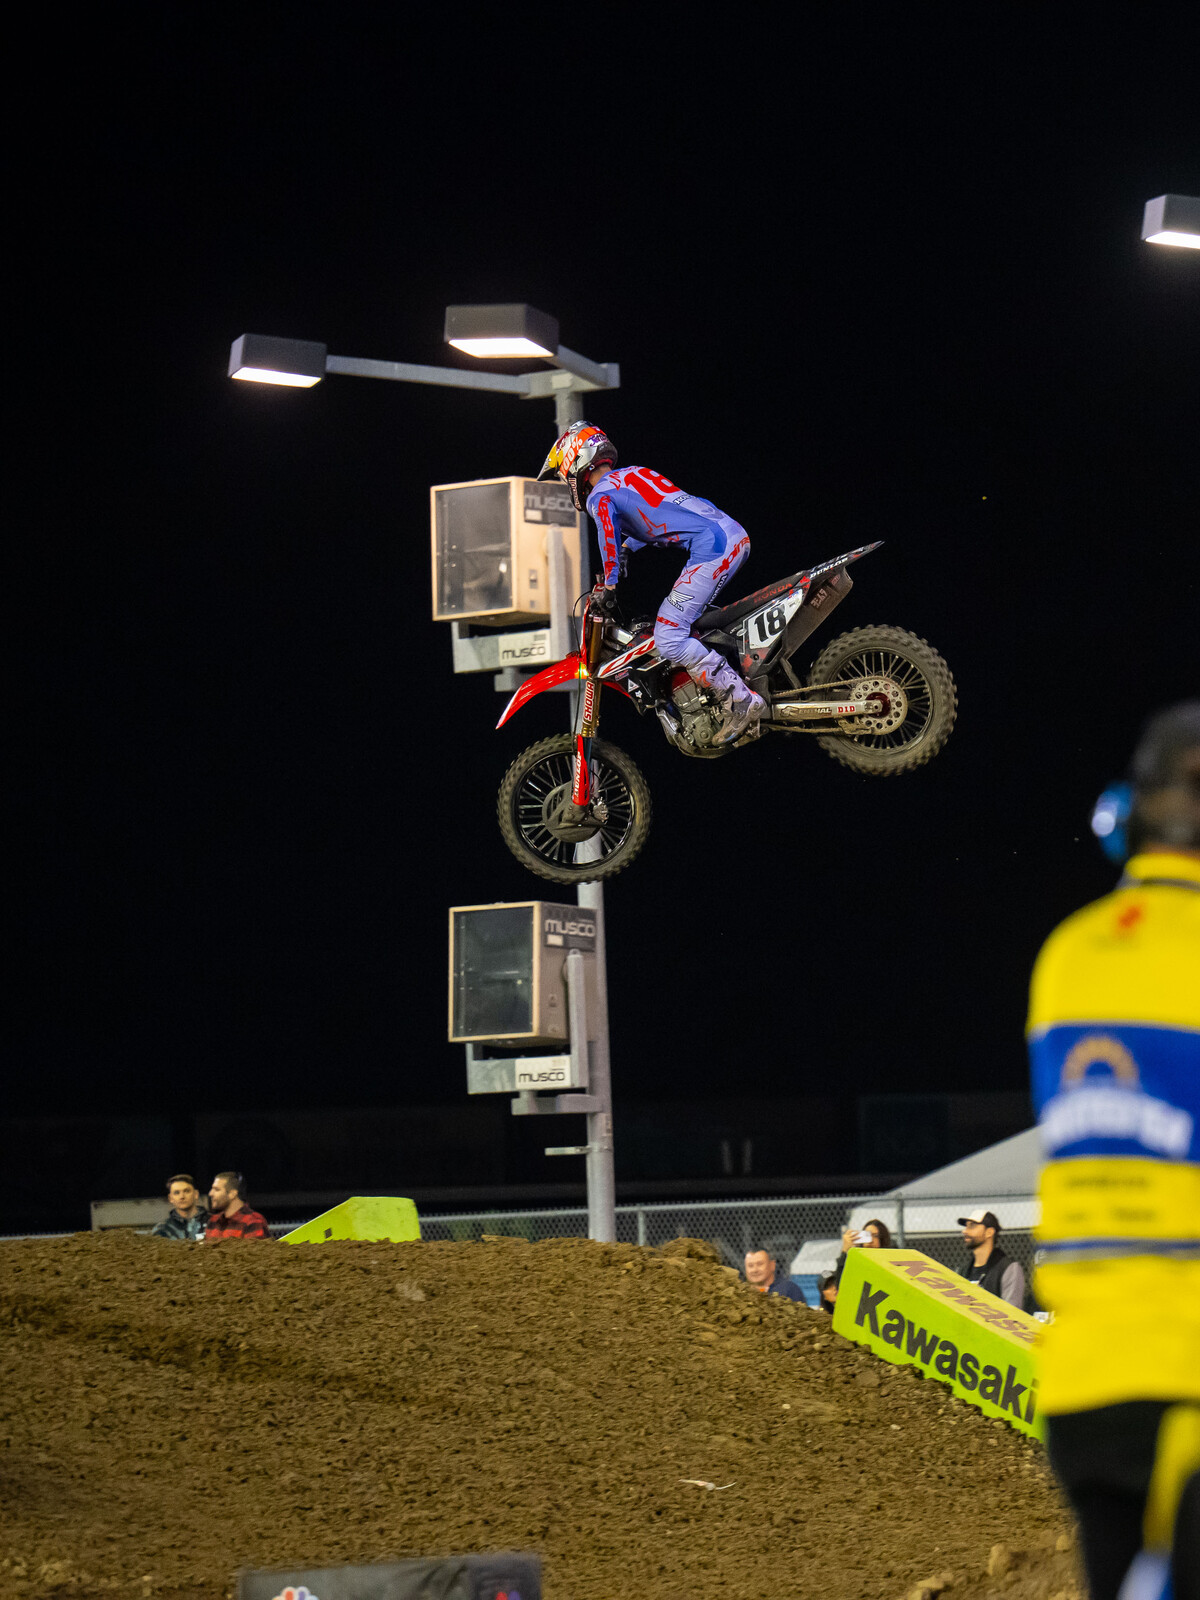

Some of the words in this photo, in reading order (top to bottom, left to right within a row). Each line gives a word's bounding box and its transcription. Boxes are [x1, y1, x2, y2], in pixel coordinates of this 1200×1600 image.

[560, 436, 583, 477] 100%
[624, 467, 681, 508] 18
[754, 604, 787, 643] 18
[584, 682, 594, 720] SHOWA
[855, 1281, 1040, 1425] Kawasaki
